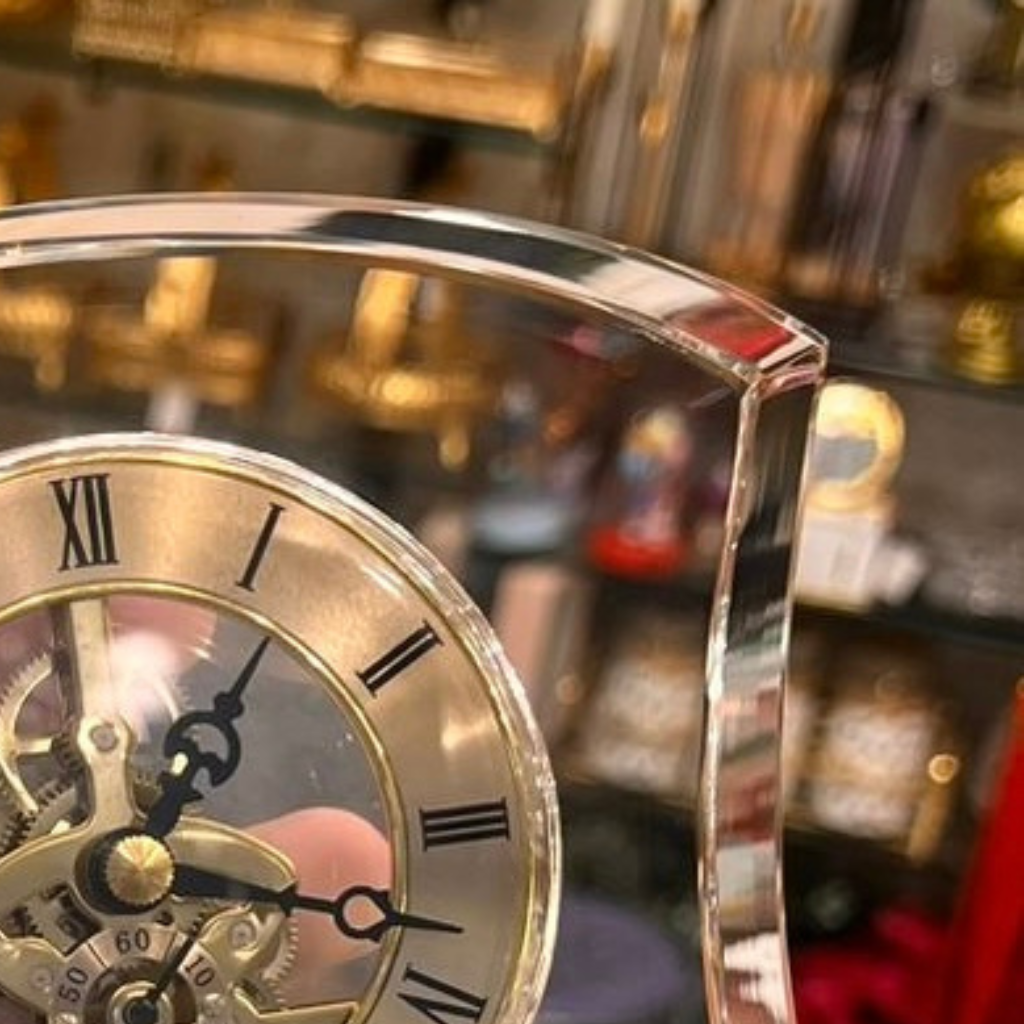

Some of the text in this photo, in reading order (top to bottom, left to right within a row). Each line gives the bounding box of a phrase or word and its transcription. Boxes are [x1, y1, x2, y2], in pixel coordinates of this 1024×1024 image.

[49, 473, 119, 571] XII
[235, 503, 284, 592] I
[356, 620, 443, 696] II
[419, 797, 512, 853] III
[115, 928, 149, 953] 60
[58, 966, 88, 1001] 50
[183, 955, 215, 987] 10
